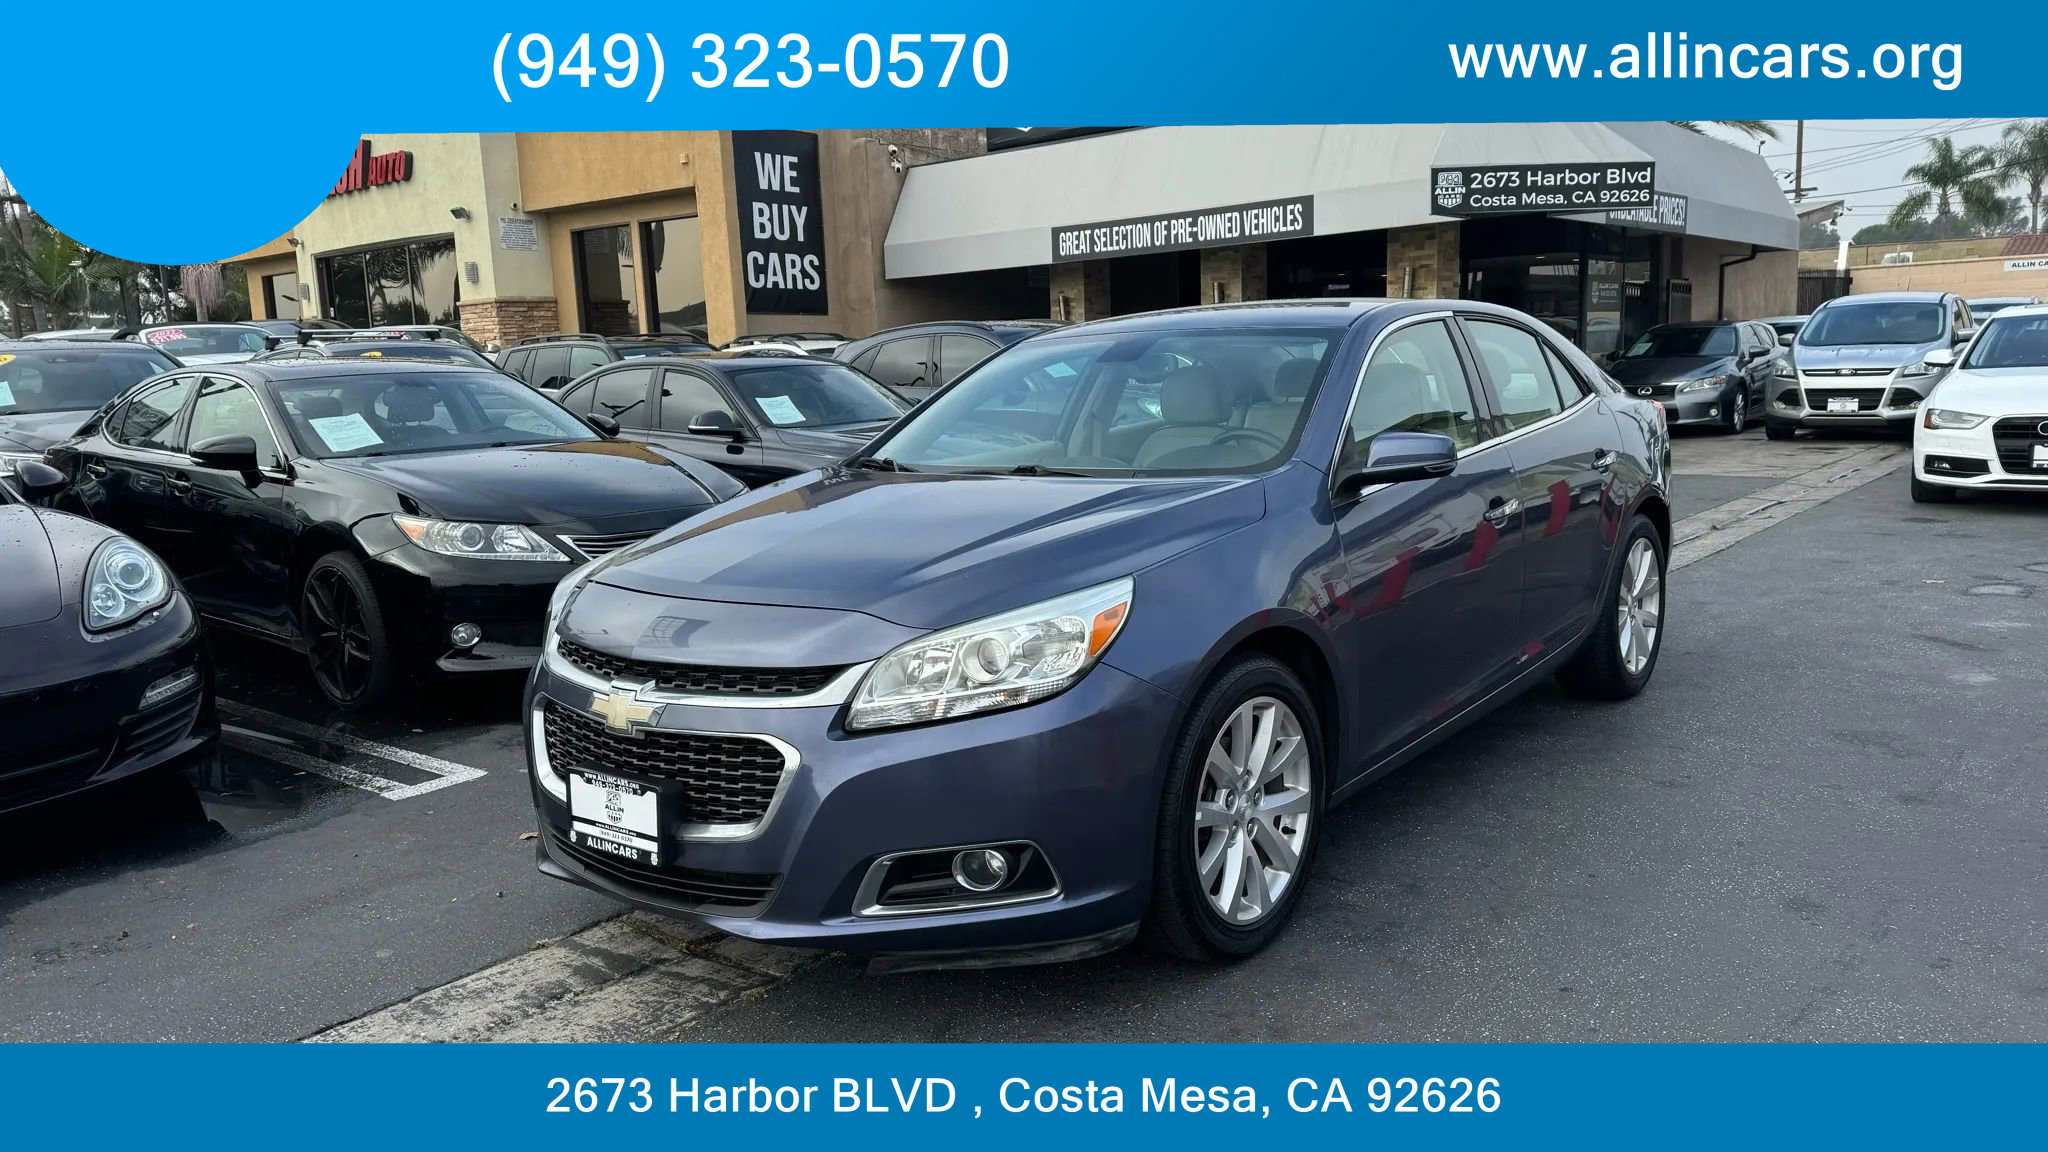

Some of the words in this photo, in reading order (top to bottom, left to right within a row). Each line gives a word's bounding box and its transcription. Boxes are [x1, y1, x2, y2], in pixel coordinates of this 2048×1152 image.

[367, 150, 408, 186] AUTO
[754, 151, 800, 193] WE
[1470, 171, 1520, 188] 2673
[1527, 169, 1601, 187] Harbor
[1606, 166, 1651, 184] Blvd
[1434, 186, 1466, 195] ALLIN
[1470, 194, 1517, 207] Costa
[1522, 192, 1568, 205] Mesa,
[1572, 190, 1596, 203] CA
[1600, 189, 1650, 203] 92626
[752, 201, 808, 242] BUY
[1659, 195, 1686, 227] PRICES!
[1059, 229, 1092, 256] GREAT
[1093, 222, 1151, 253] SELECTION
[1153, 220, 1168, 246] OF
[1170, 211, 1240, 244] PRE-OWNED
[1243, 203, 1303, 236] VEHICLES
[746, 250, 821, 291] CARS
[604, 802, 625, 814] ALLIN
[587, 836, 638, 860] ALLINCARS
